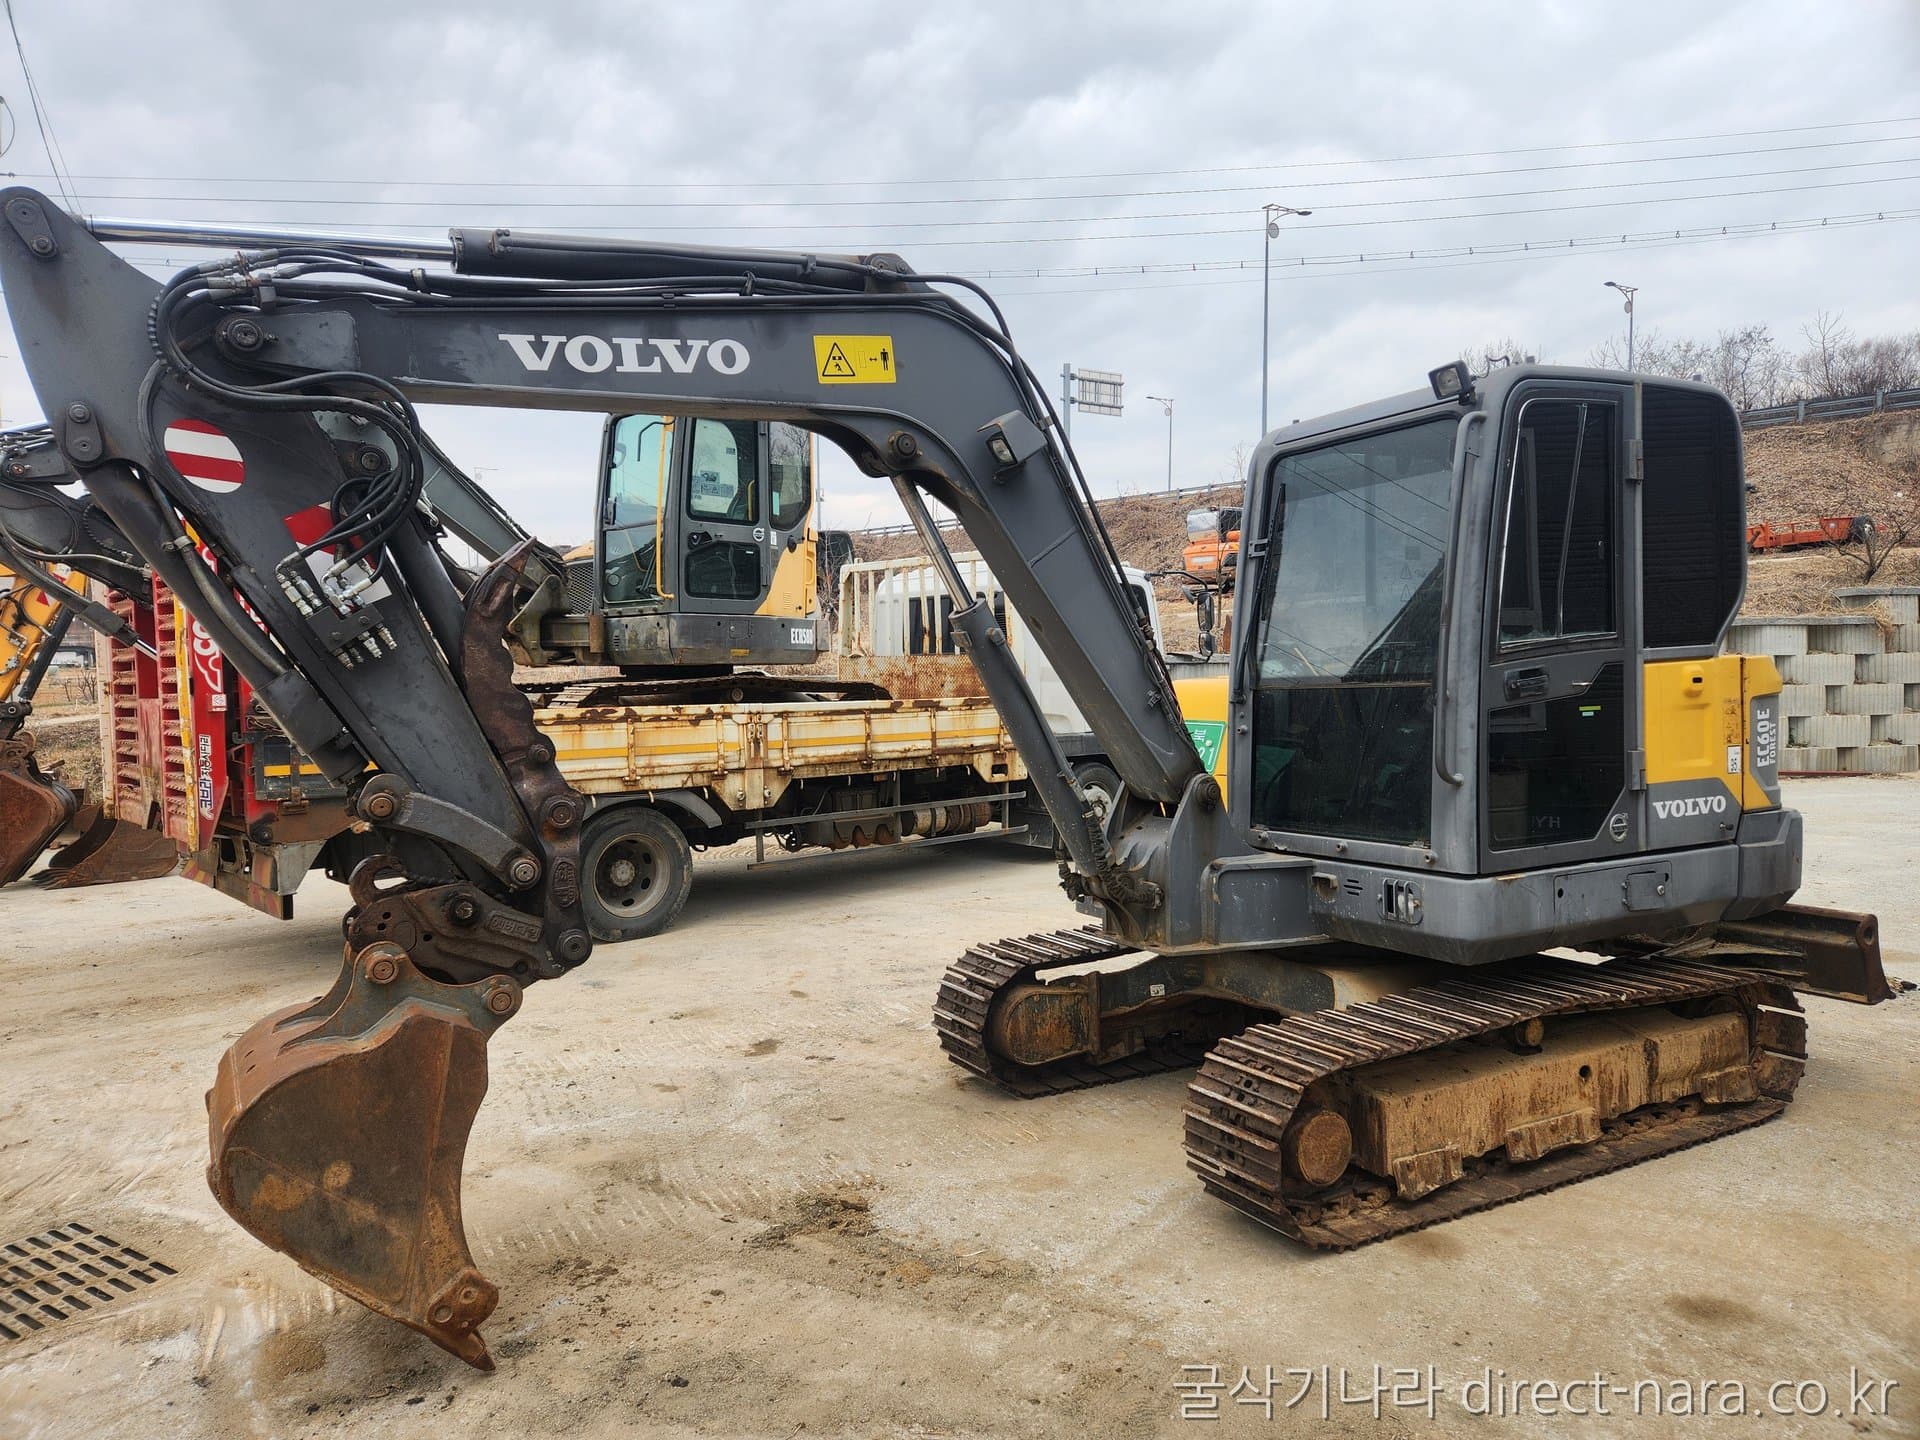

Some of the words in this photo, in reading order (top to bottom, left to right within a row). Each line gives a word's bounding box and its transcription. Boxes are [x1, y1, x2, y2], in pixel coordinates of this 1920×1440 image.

[498, 334, 750, 375] VOLVO
[1757, 708, 1770, 767] EC60E
[1769, 722, 1777, 764] FOREST
[1652, 795, 1727, 820] VOLVO
